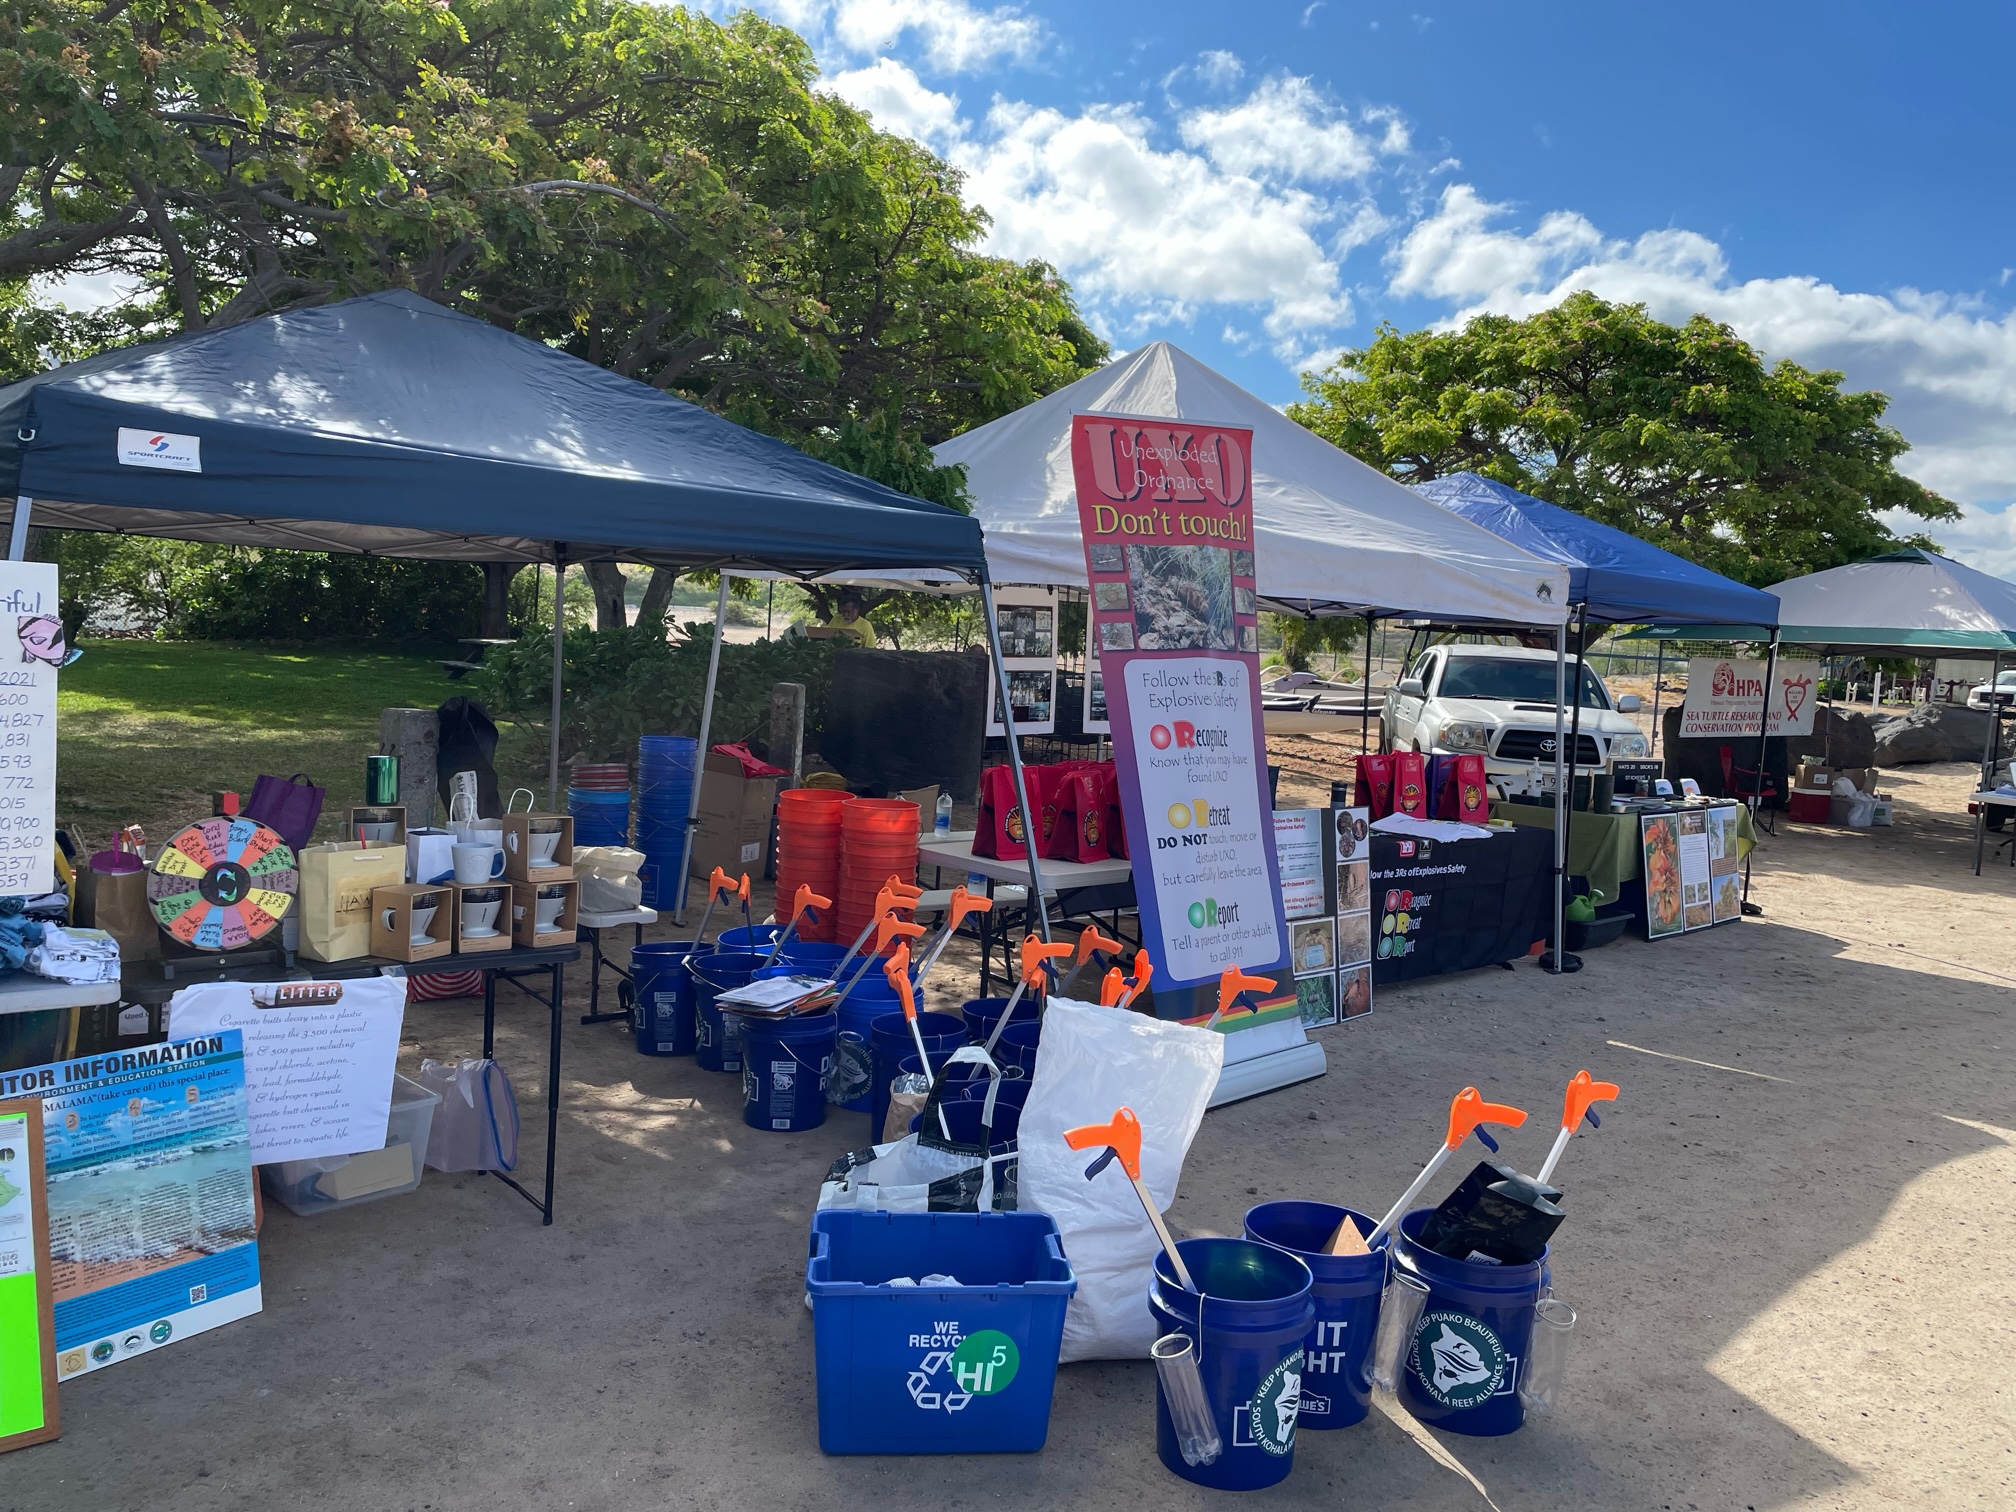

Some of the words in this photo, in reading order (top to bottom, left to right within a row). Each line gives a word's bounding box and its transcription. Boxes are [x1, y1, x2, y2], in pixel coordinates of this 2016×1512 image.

[128, 451, 191, 461] SPORTCRAFT
[1120, 440, 1218, 464] Unexploded
[1084, 424, 1246, 507] UXO
[1133, 469, 1214, 490] Ordnance
[1179, 512, 1247, 542] touch!
[0, 590, 41, 613] iful
[0, 672, 35, 685] 2021
[1142, 670, 1189, 688] Follow
[1193, 668, 1211, 685] the
[1229, 670, 1240, 687] of
[1736, 680, 1763, 696] HPA
[1149, 690, 1213, 712] Explosives
[1213, 689, 1238, 712] Safety
[1686, 711, 1699, 721] SEA
[1702, 711, 1730, 721] TURTLE
[1173, 719, 1228, 752] Recognize
[1686, 723, 1742, 733] CONSERVATION
[1150, 755, 1180, 769] Know
[1183, 751, 1203, 766] that
[1205, 755, 1217, 766] you
[1218, 755, 1231, 766] may
[1232, 752, 1248, 765] have
[1187, 769, 1212, 783] found
[1213, 770, 1228, 782] UXO
[1192, 799, 1231, 828] Retreat
[1157, 836, 1177, 849] DO
[1182, 833, 1208, 847] NOT
[1229, 833, 1248, 843] move
[1249, 832, 1257, 840] or
[1195, 849, 1218, 864] disturb
[1162, 873, 1181, 886] but
[1185, 867, 1217, 885] carefully
[1217, 868, 1234, 880] leave
[1235, 865, 1246, 877] the
[1247, 866, 1262, 876] area
[1370, 870, 1382, 879] low
[1384, 869, 1393, 878] the
[1395, 868, 1407, 877] 3Rs
[1408, 867, 1415, 876] of
[1415, 865, 1447, 877] Explosives
[1447, 864, 1467, 874] Safety
[1205, 897, 1239, 929] Report
[1171, 935, 1192, 951] Tell
[1195, 939, 1200, 948] a
[1201, 933, 1222, 950] parent
[1222, 934, 1230, 943] or
[1232, 928, 1251, 941] other
[1251, 922, 1272, 938] adult
[1210, 951, 1218, 963] to
[1220, 947, 1231, 962] call
[1232, 946, 1243, 960] 911
[279, 985, 338, 1000] LITTER
[125, 1012, 143, 1020] Used
[220, 1013, 260, 1027] Cigarette
[263, 1014, 281, 1024] butts
[284, 1012, 308, 1023] decay
[336, 1009, 362, 1020] plastic
[249, 1031, 285, 1041] releasing
[288, 1028, 299, 1038] the
[330, 1021, 366, 1034] chemical
[257, 1046, 269, 1056] &
[271, 1048, 288, 1056] 500
[317, 1039, 355, 1050] including
[0, 1069, 55, 1095] ITOR
[65, 1036, 223, 1082] INFORMATION
[98, 1079, 104, 1087] &
[109, 1068, 163, 1084] EDUCATION
[167, 1059, 206, 1073] STATION
[256, 1061, 278, 1072] vinyl
[119, 1085, 140, 1097] care
[142, 1082, 156, 1095] of)
[158, 1077, 174, 1089] this
[176, 1073, 206, 1089] special
[207, 1067, 231, 1082] place:
[256, 1092, 268, 1103] &
[269, 1091, 307, 1103] hydrogen
[249, 1110, 280, 1120] igarette
[283, 1106, 298, 1115] butt
[301, 1099, 339, 1113] chemicals
[267, 1137, 291, 1147] threat
[303, 1133, 334, 1143] aquatic
[934, 1321, 959, 1334] WE
[1316, 1321, 1348, 1347] IT
[1418, 1316, 1431, 1333] KEEP
[1431, 1313, 1463, 1324] PUAKO
[1464, 1319, 1502, 1357] BEAUTIFUL
[909, 1335, 966, 1348] RECYC
[956, 1362, 994, 1392] HI
[991, 1346, 1007, 1367] 5
[1257, 1374, 1275, 1399] KEEP
[1275, 1353, 1298, 1377] PUAKO
[1412, 1337, 1422, 1371] SOUTH
[1418, 1373, 1450, 1405] KOHALA
[1451, 1398, 1474, 1408] REEF
[1476, 1364, 1503, 1403] ALLIANCE
[1252, 1406, 1266, 1441] SOUTH
[1262, 1437, 1288, 1455] KOHALA
